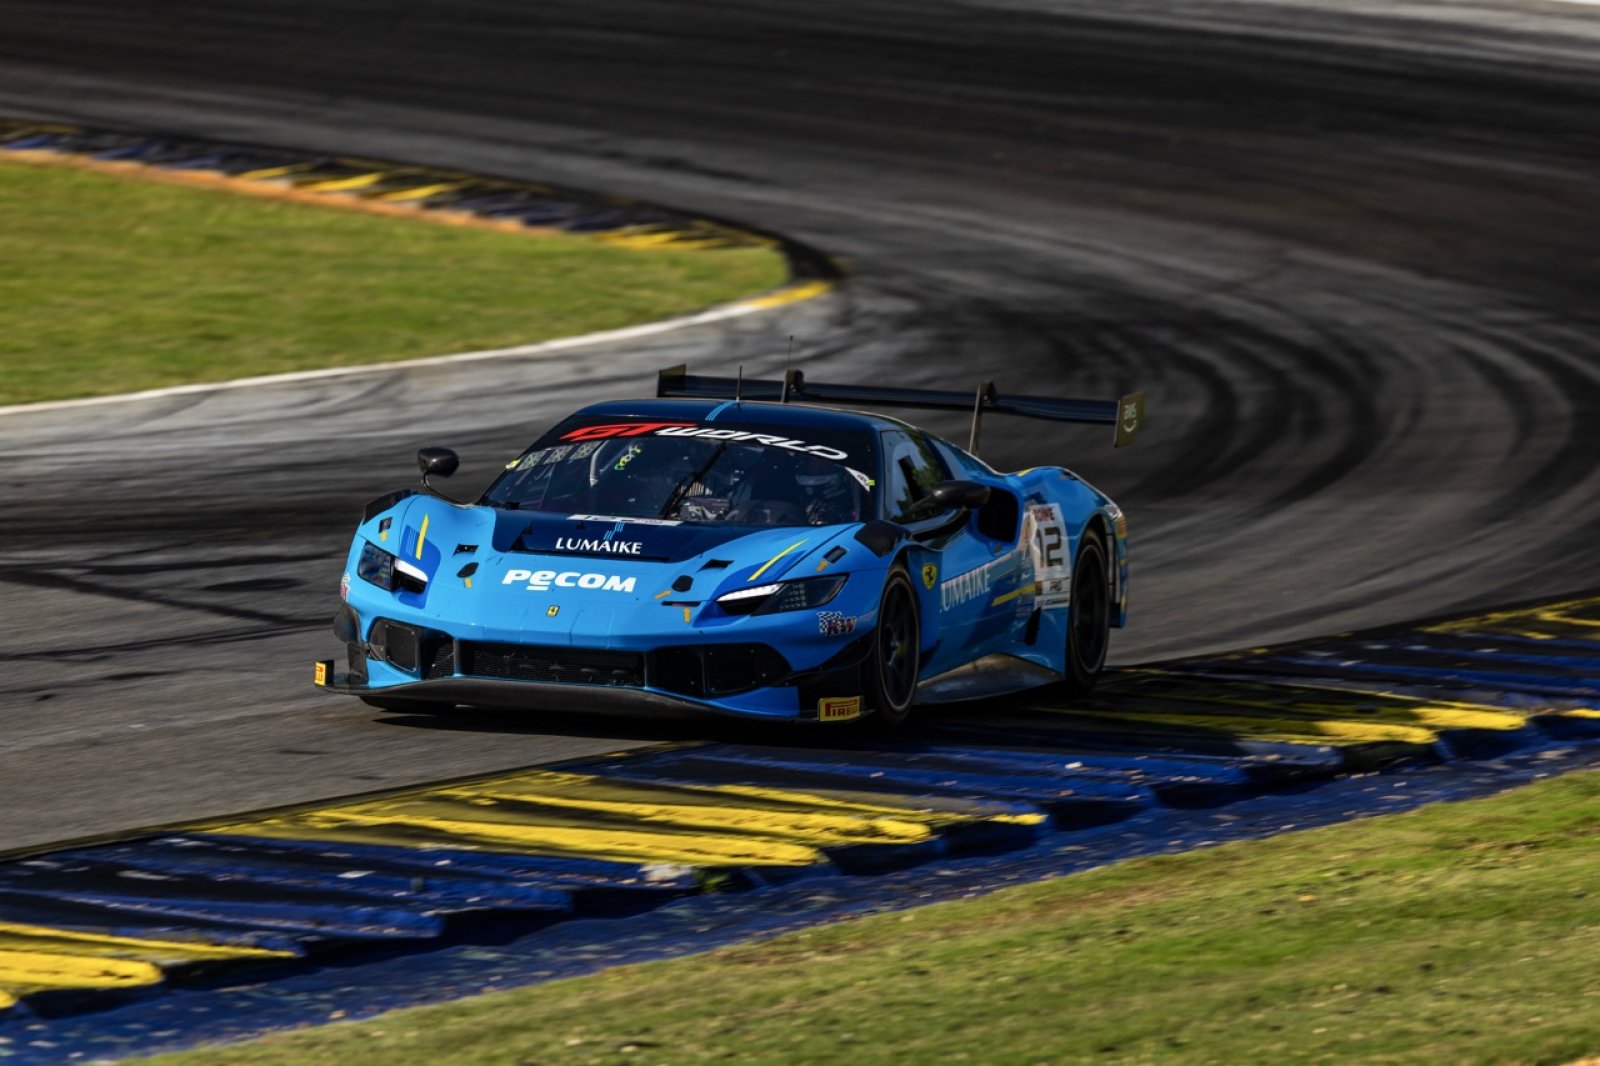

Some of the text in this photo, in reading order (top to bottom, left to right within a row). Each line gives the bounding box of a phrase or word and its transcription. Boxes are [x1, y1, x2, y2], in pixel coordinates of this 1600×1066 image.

[655, 426, 848, 460] WORLD
[555, 537, 642, 555] LUMAIKE
[1036, 526, 1063, 568] 12
[939, 562, 992, 614] UMAIKE
